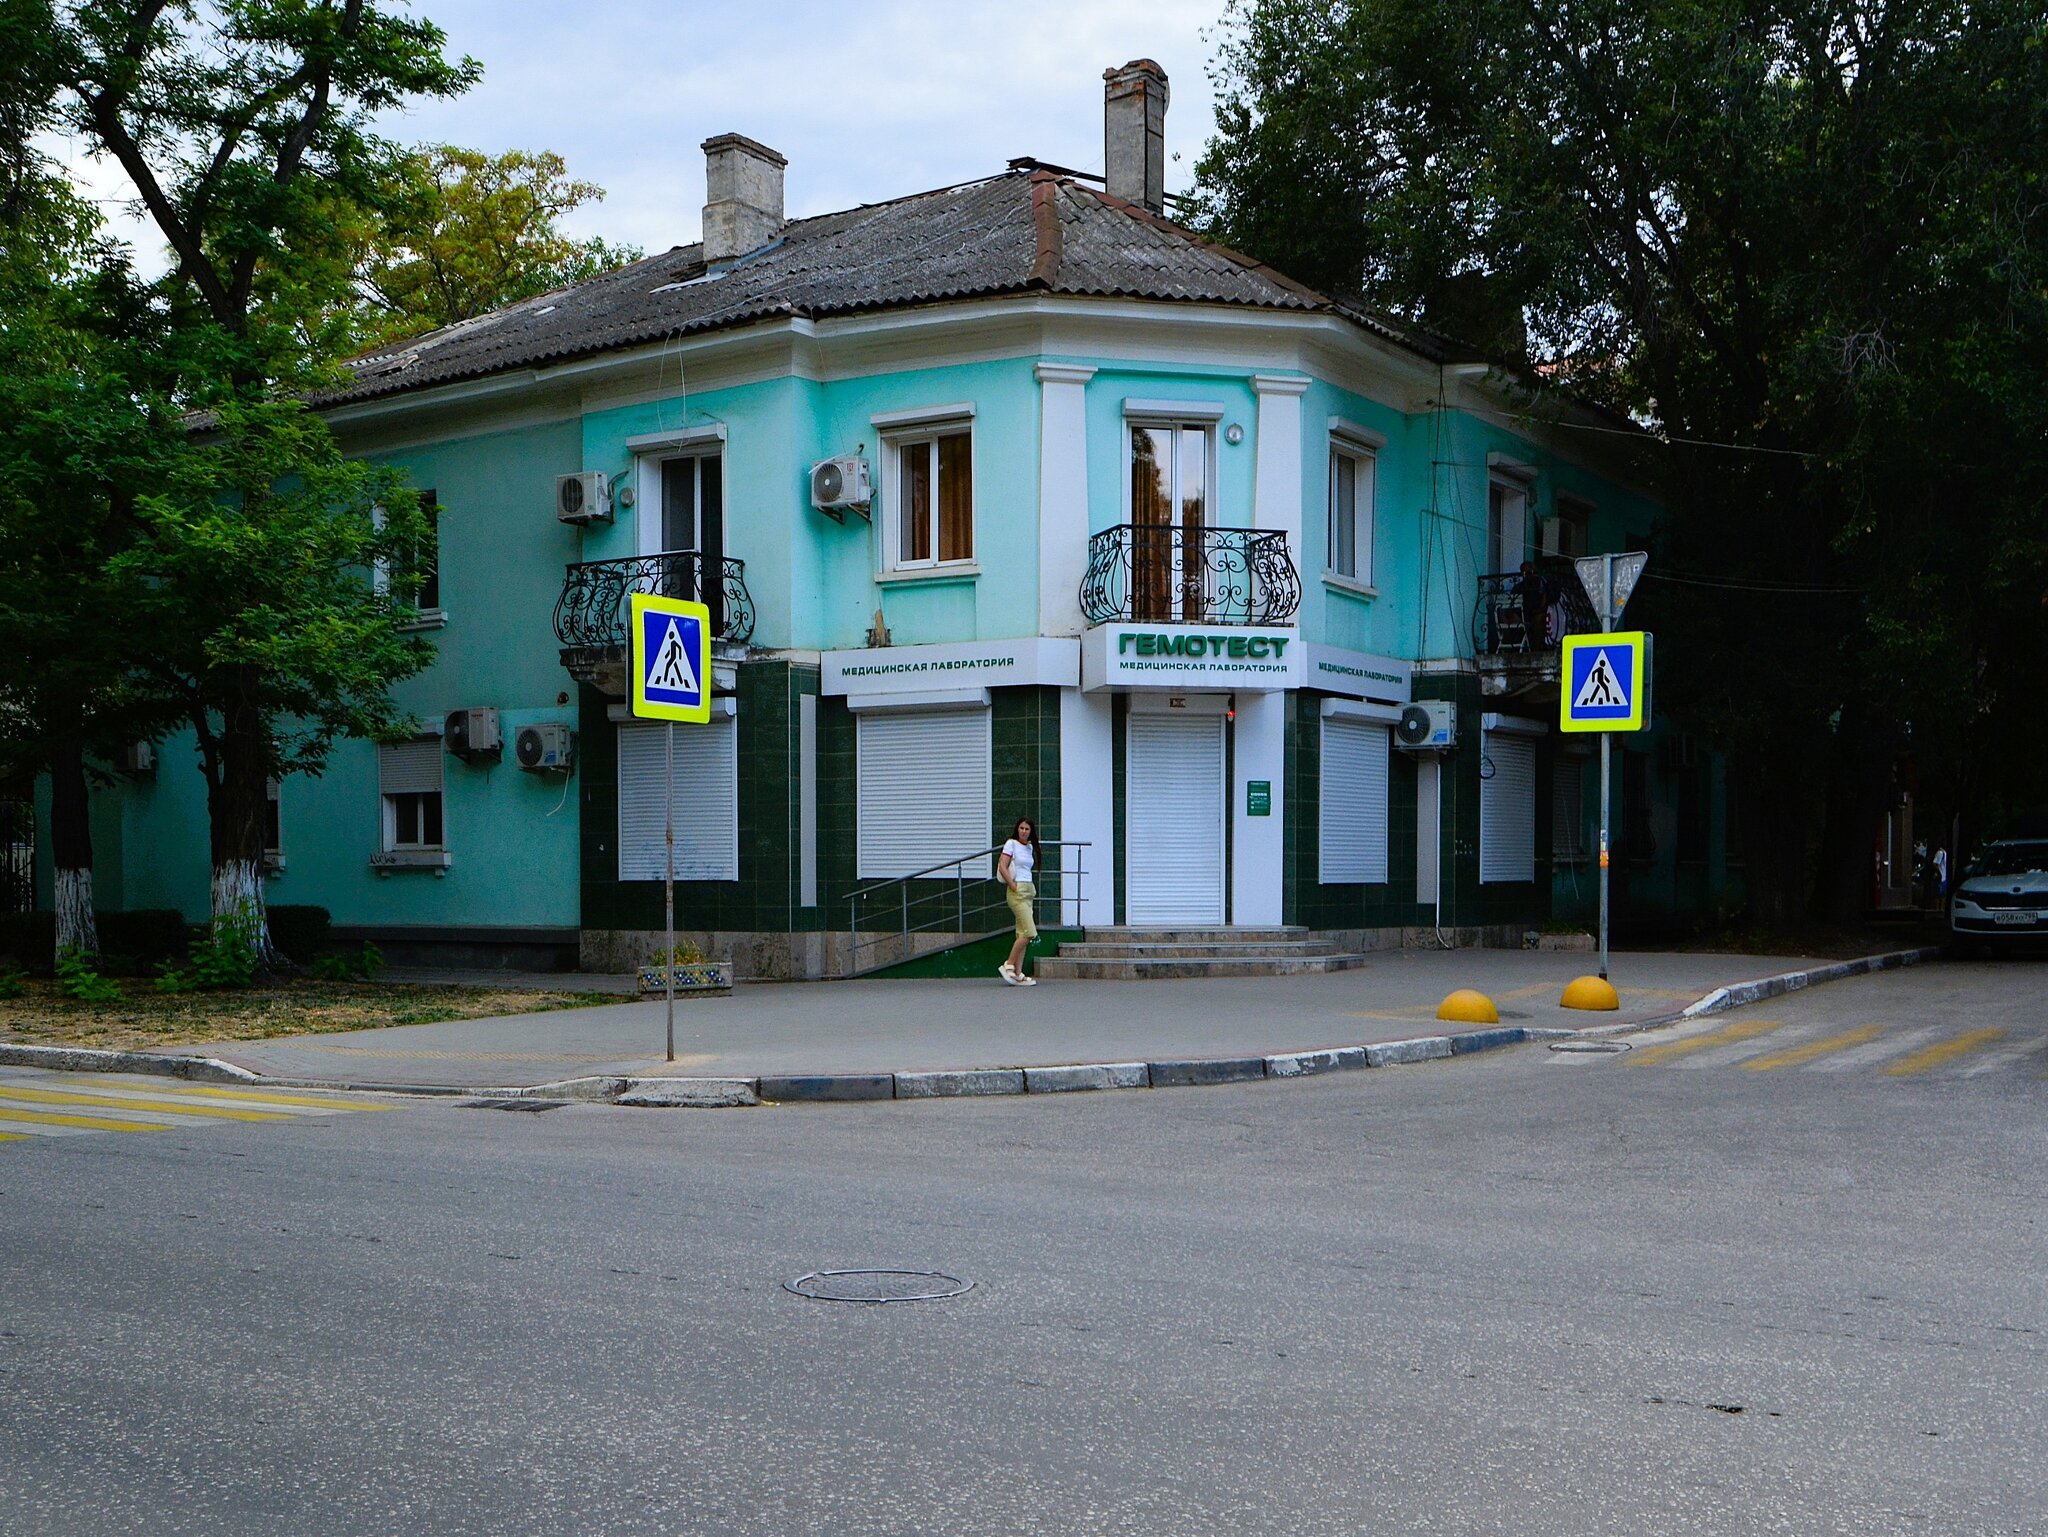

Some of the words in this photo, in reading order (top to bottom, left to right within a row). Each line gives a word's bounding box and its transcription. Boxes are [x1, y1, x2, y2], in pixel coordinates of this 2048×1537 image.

[1119, 633, 1290, 658] ГЕМОТЕСТ
[841, 662, 928, 677] МЕДИЦИНСКАЯ
[930, 657, 1014, 671] ЛАБОРАТОРИЯ
[1119, 661, 1206, 671] МЕДИЦИНСКАЯ
[1209, 664, 1288, 673] ЛАБОРАТОРИЯ
[1318, 662, 1364, 677] МЕДИЦИНСКАЯ
[1364, 670, 1403, 684] ЛАБОРАТОРИЯ
